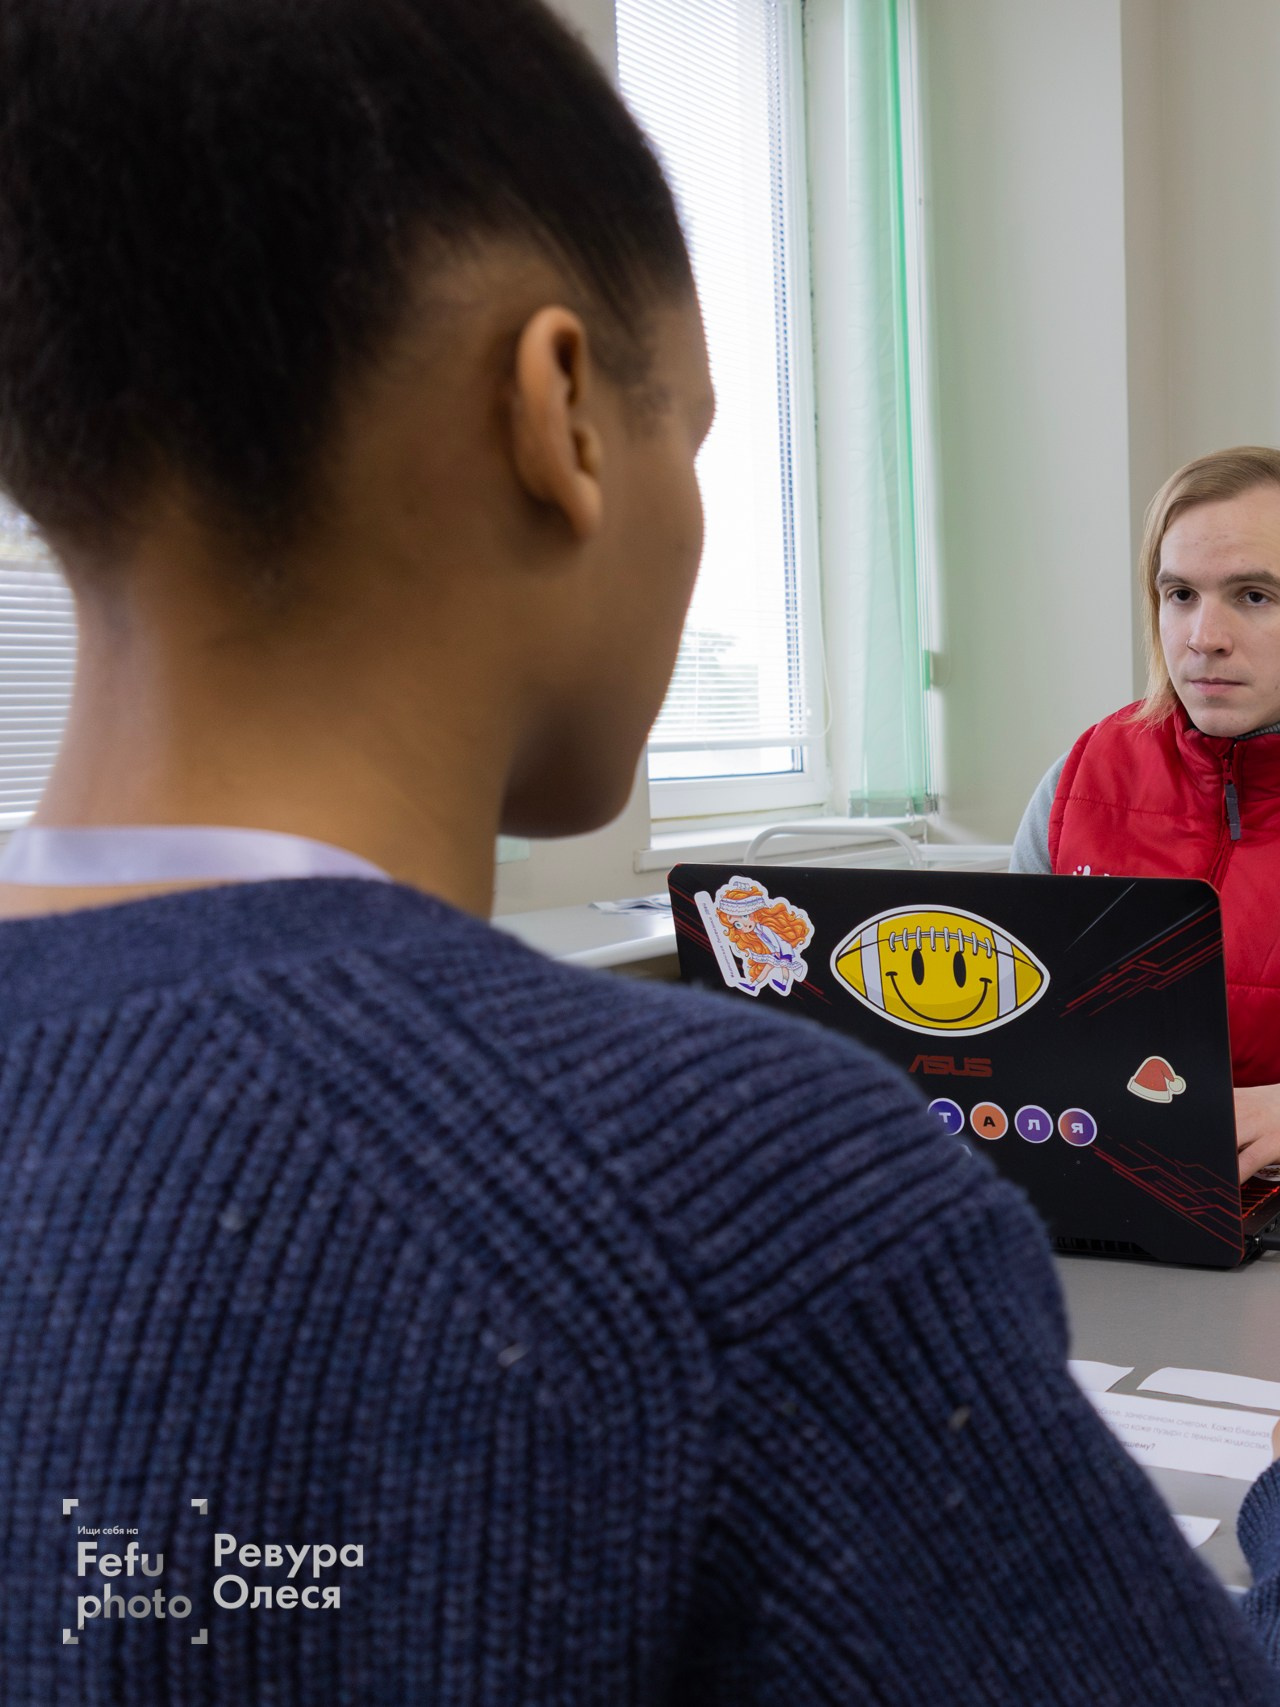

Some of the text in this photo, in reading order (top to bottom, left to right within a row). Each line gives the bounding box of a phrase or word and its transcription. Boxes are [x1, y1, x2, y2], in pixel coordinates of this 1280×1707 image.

[908, 1054, 993, 1078] ASUS
[1131, 1424, 1152, 1432] коже
[1211, 1422, 1233, 1434] Кожа
